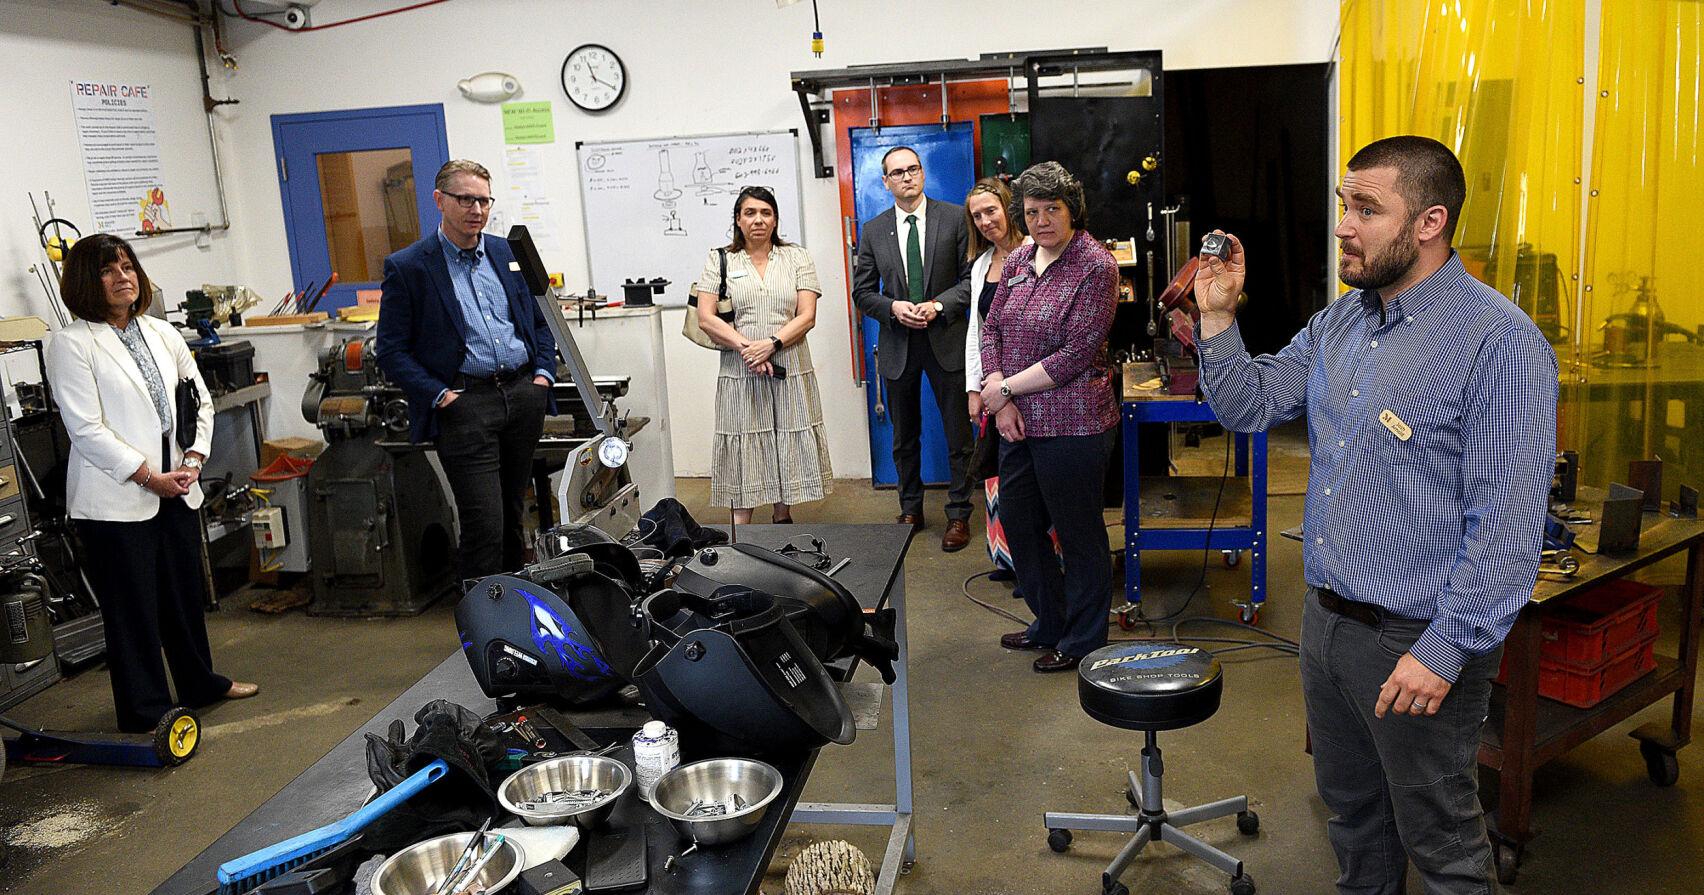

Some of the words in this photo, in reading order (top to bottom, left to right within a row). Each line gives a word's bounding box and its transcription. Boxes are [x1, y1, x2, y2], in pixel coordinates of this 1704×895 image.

[580, 55, 587, 63] 11
[589, 51, 598, 59] 12
[573, 63, 581, 71] 10
[609, 61, 616, 69] 2
[570, 75, 576, 83] 9
[614, 72, 619, 80] 3
[76, 83, 117, 97] REPAIR
[121, 85, 148, 98] CAFE
[574, 87, 580, 95] 8
[594, 96, 600, 104] 6
[604, 92, 610, 100] 5
[1090, 648, 1200, 671] ParkTool
[1110, 675, 1133, 683] BIKE
